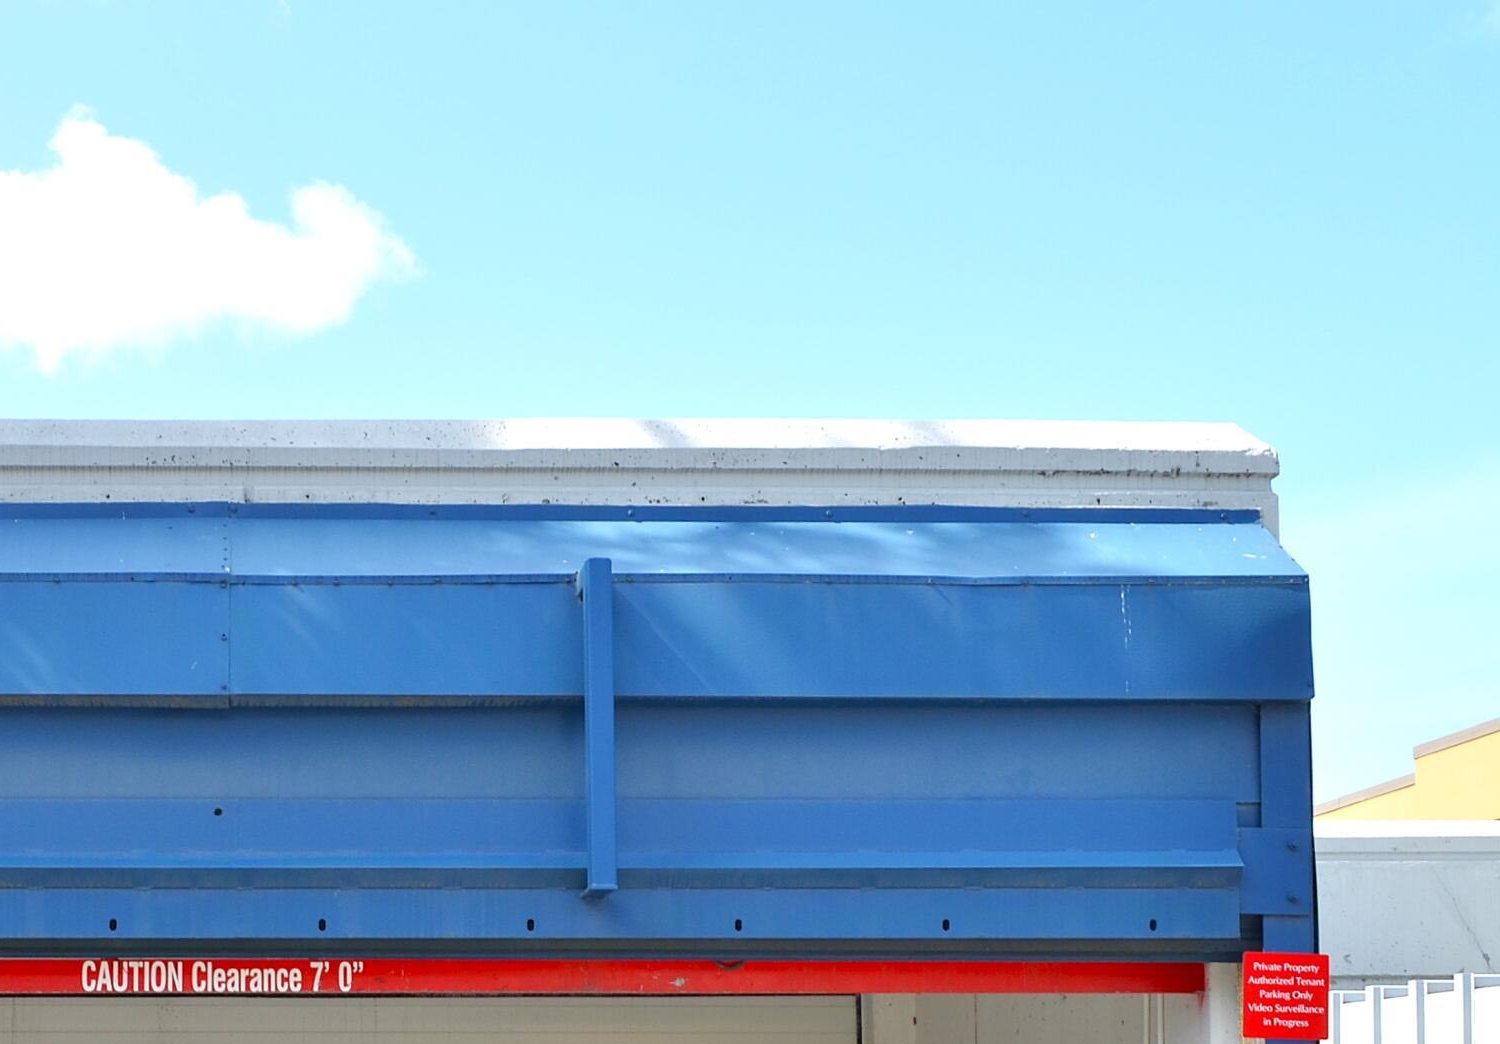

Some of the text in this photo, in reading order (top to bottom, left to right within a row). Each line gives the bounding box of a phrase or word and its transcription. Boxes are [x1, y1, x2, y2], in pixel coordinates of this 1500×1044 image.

[1253, 961, 1320, 974] Private Property
[81, 960, 183, 993] CAUTION
[192, 960, 302, 993] Clearance
[1248, 976, 1325, 986] Authorized Tenant
[1259, 989, 1314, 1001] Parking Only
[1248, 1003, 1325, 1014] Video Surveillance
[1263, 1017, 1310, 1028] in Progress
